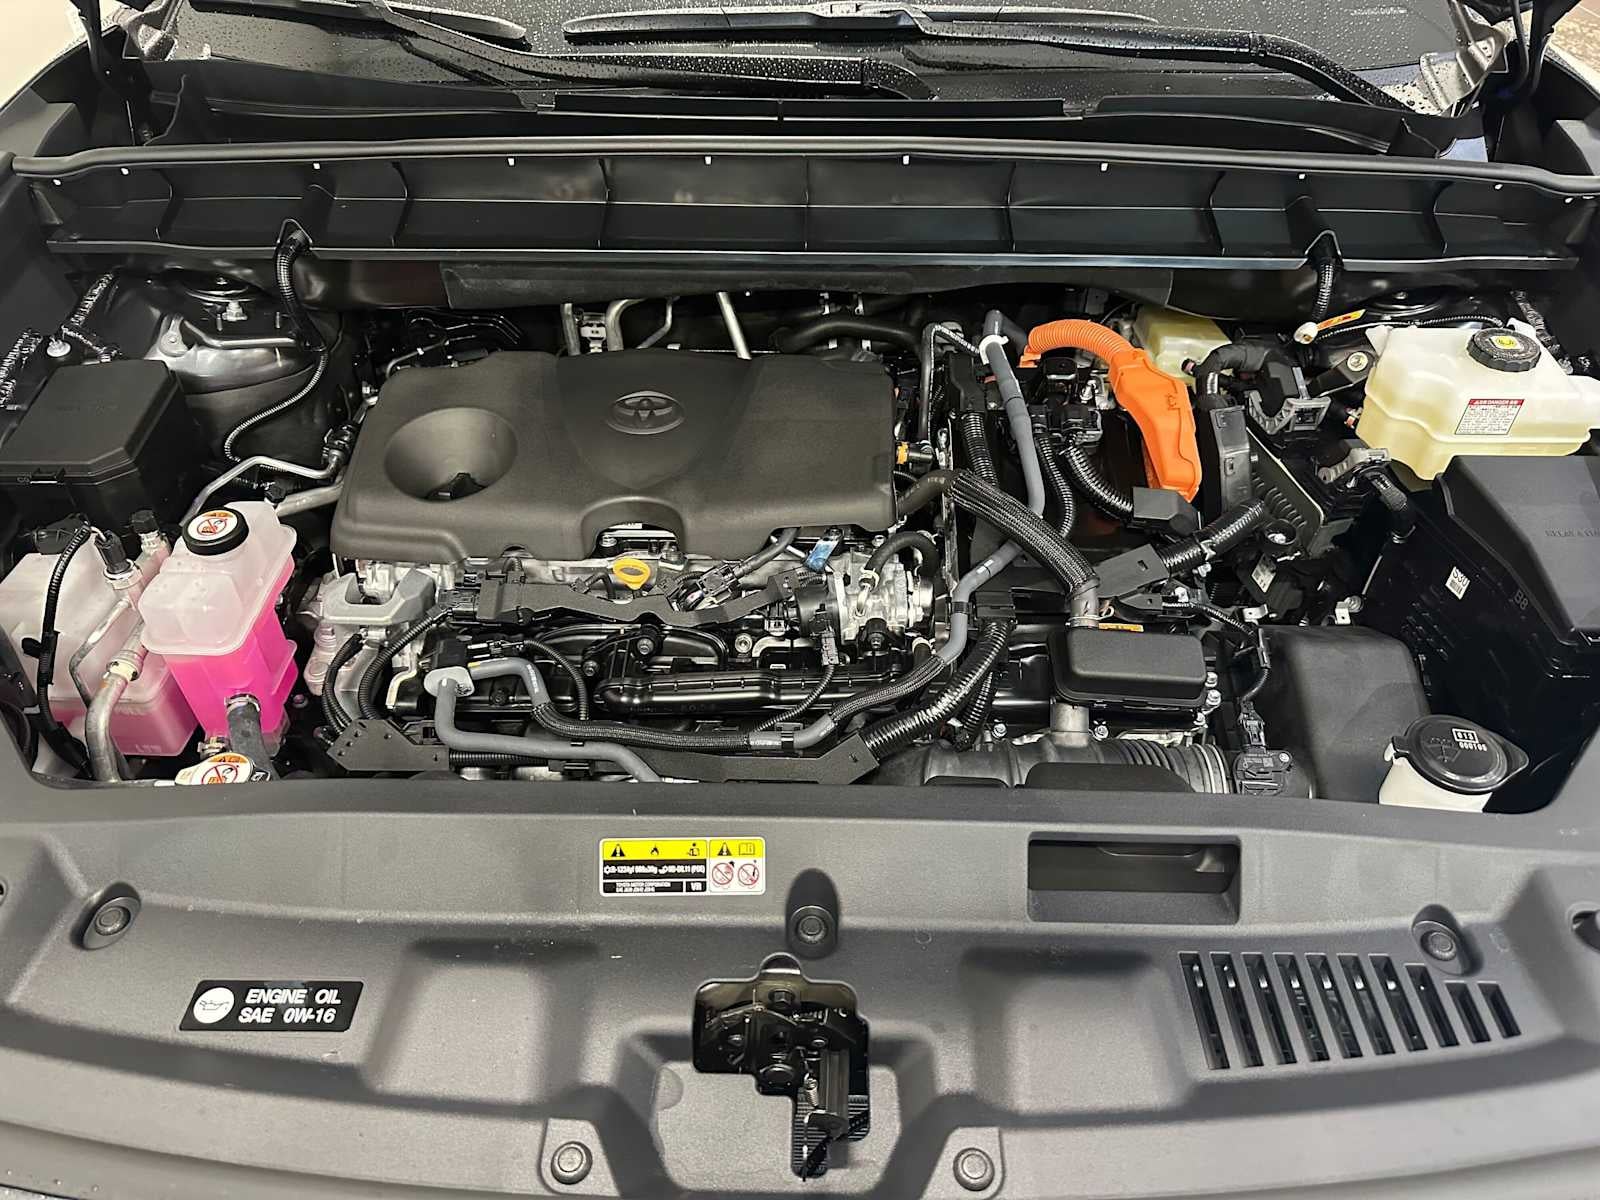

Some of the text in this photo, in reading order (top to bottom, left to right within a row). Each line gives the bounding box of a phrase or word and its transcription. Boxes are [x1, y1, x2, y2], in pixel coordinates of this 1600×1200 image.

[245, 989, 341, 1004] ENGINE OIL
[238, 1007, 337, 1024] SAE 0W-16
